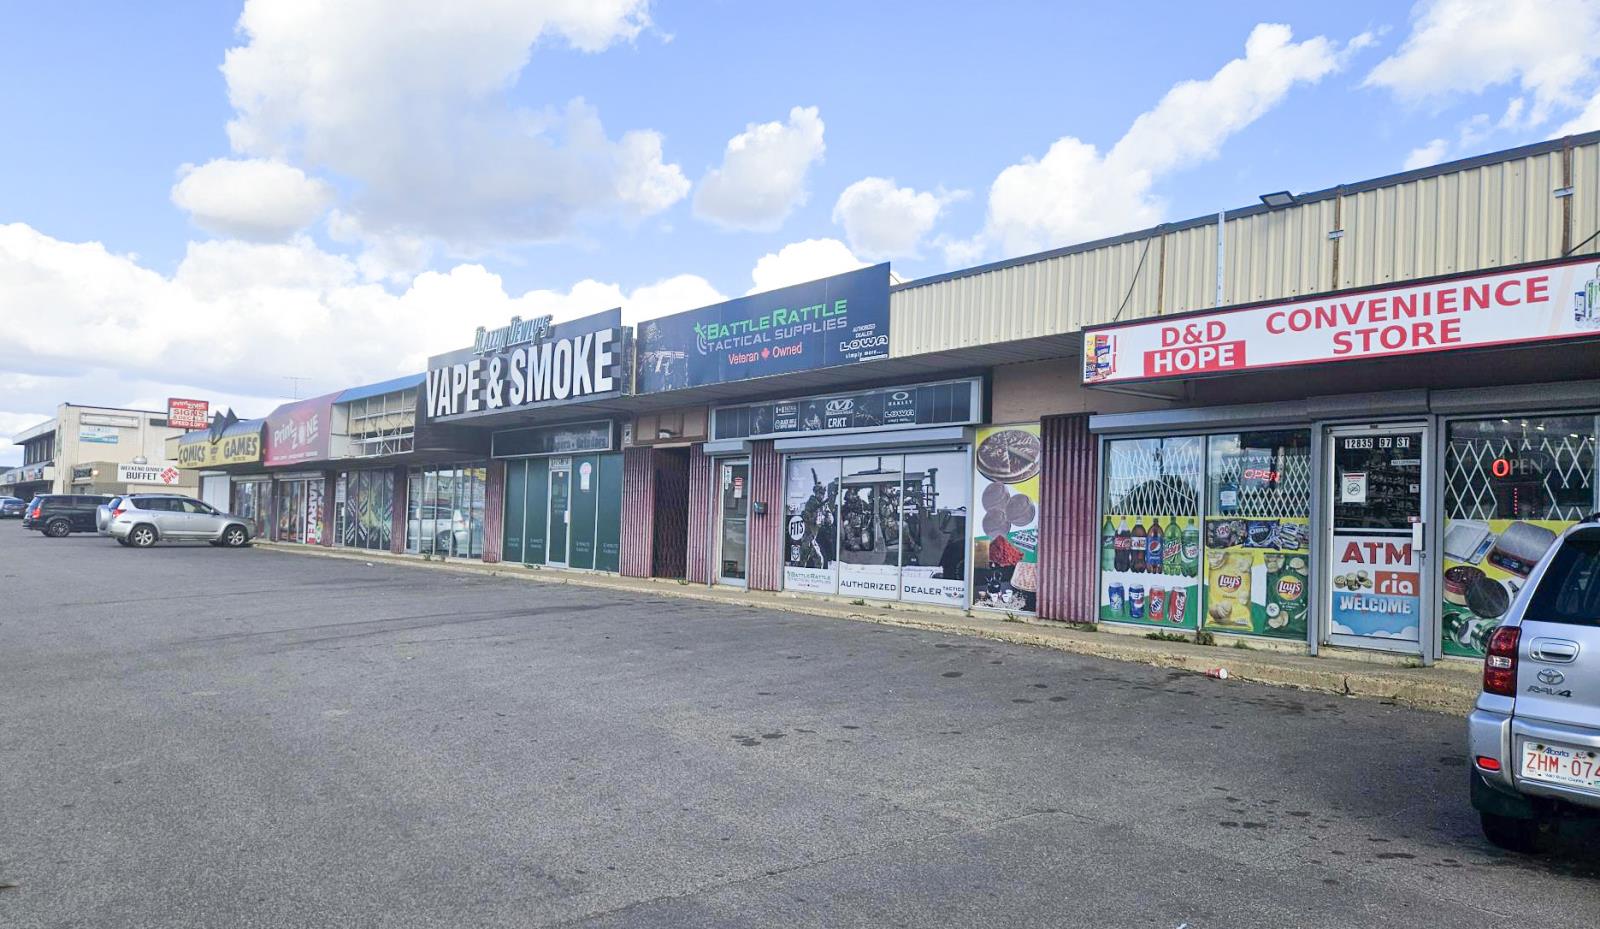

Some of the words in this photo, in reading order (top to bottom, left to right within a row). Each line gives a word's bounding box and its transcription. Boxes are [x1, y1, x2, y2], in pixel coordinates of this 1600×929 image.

[1266, 276, 1549, 334] CONVENIENCE
[707, 333, 771, 352] TACTICAL
[775, 316, 847, 340] SUPPLIES
[840, 335, 888, 351] LOWA
[1161, 320, 1226, 347] D&D
[1333, 318, 1461, 354] STORE
[728, 351, 759, 365] Veteran
[772, 341, 802, 358] Owned
[1153, 344, 1235, 373] HOPE
[426, 359, 481, 418] VAPE
[486, 357, 504, 409] &
[510, 328, 613, 406] SMOKE
[179, 445, 206, 464] COMICS
[224, 437, 258, 459] GAMES
[1379, 437, 1393, 448] 97
[1397, 437, 1410, 448] ST
[126, 471, 157, 480] BUFFET
[1244, 469, 1280, 482] OPEN
[1492, 459, 1543, 477] OPEN
[791, 520, 804, 536] FITS
[1341, 542, 1412, 566] ATM
[840, 579, 897, 592] AUTHORIZED
[904, 585, 942, 596] DEALER
[1381, 573, 1414, 594] ria
[1340, 595, 1413, 614] WELCOME
[1527, 685, 1572, 698] RAV4
[1543, 747, 1569, 758] Alberta
